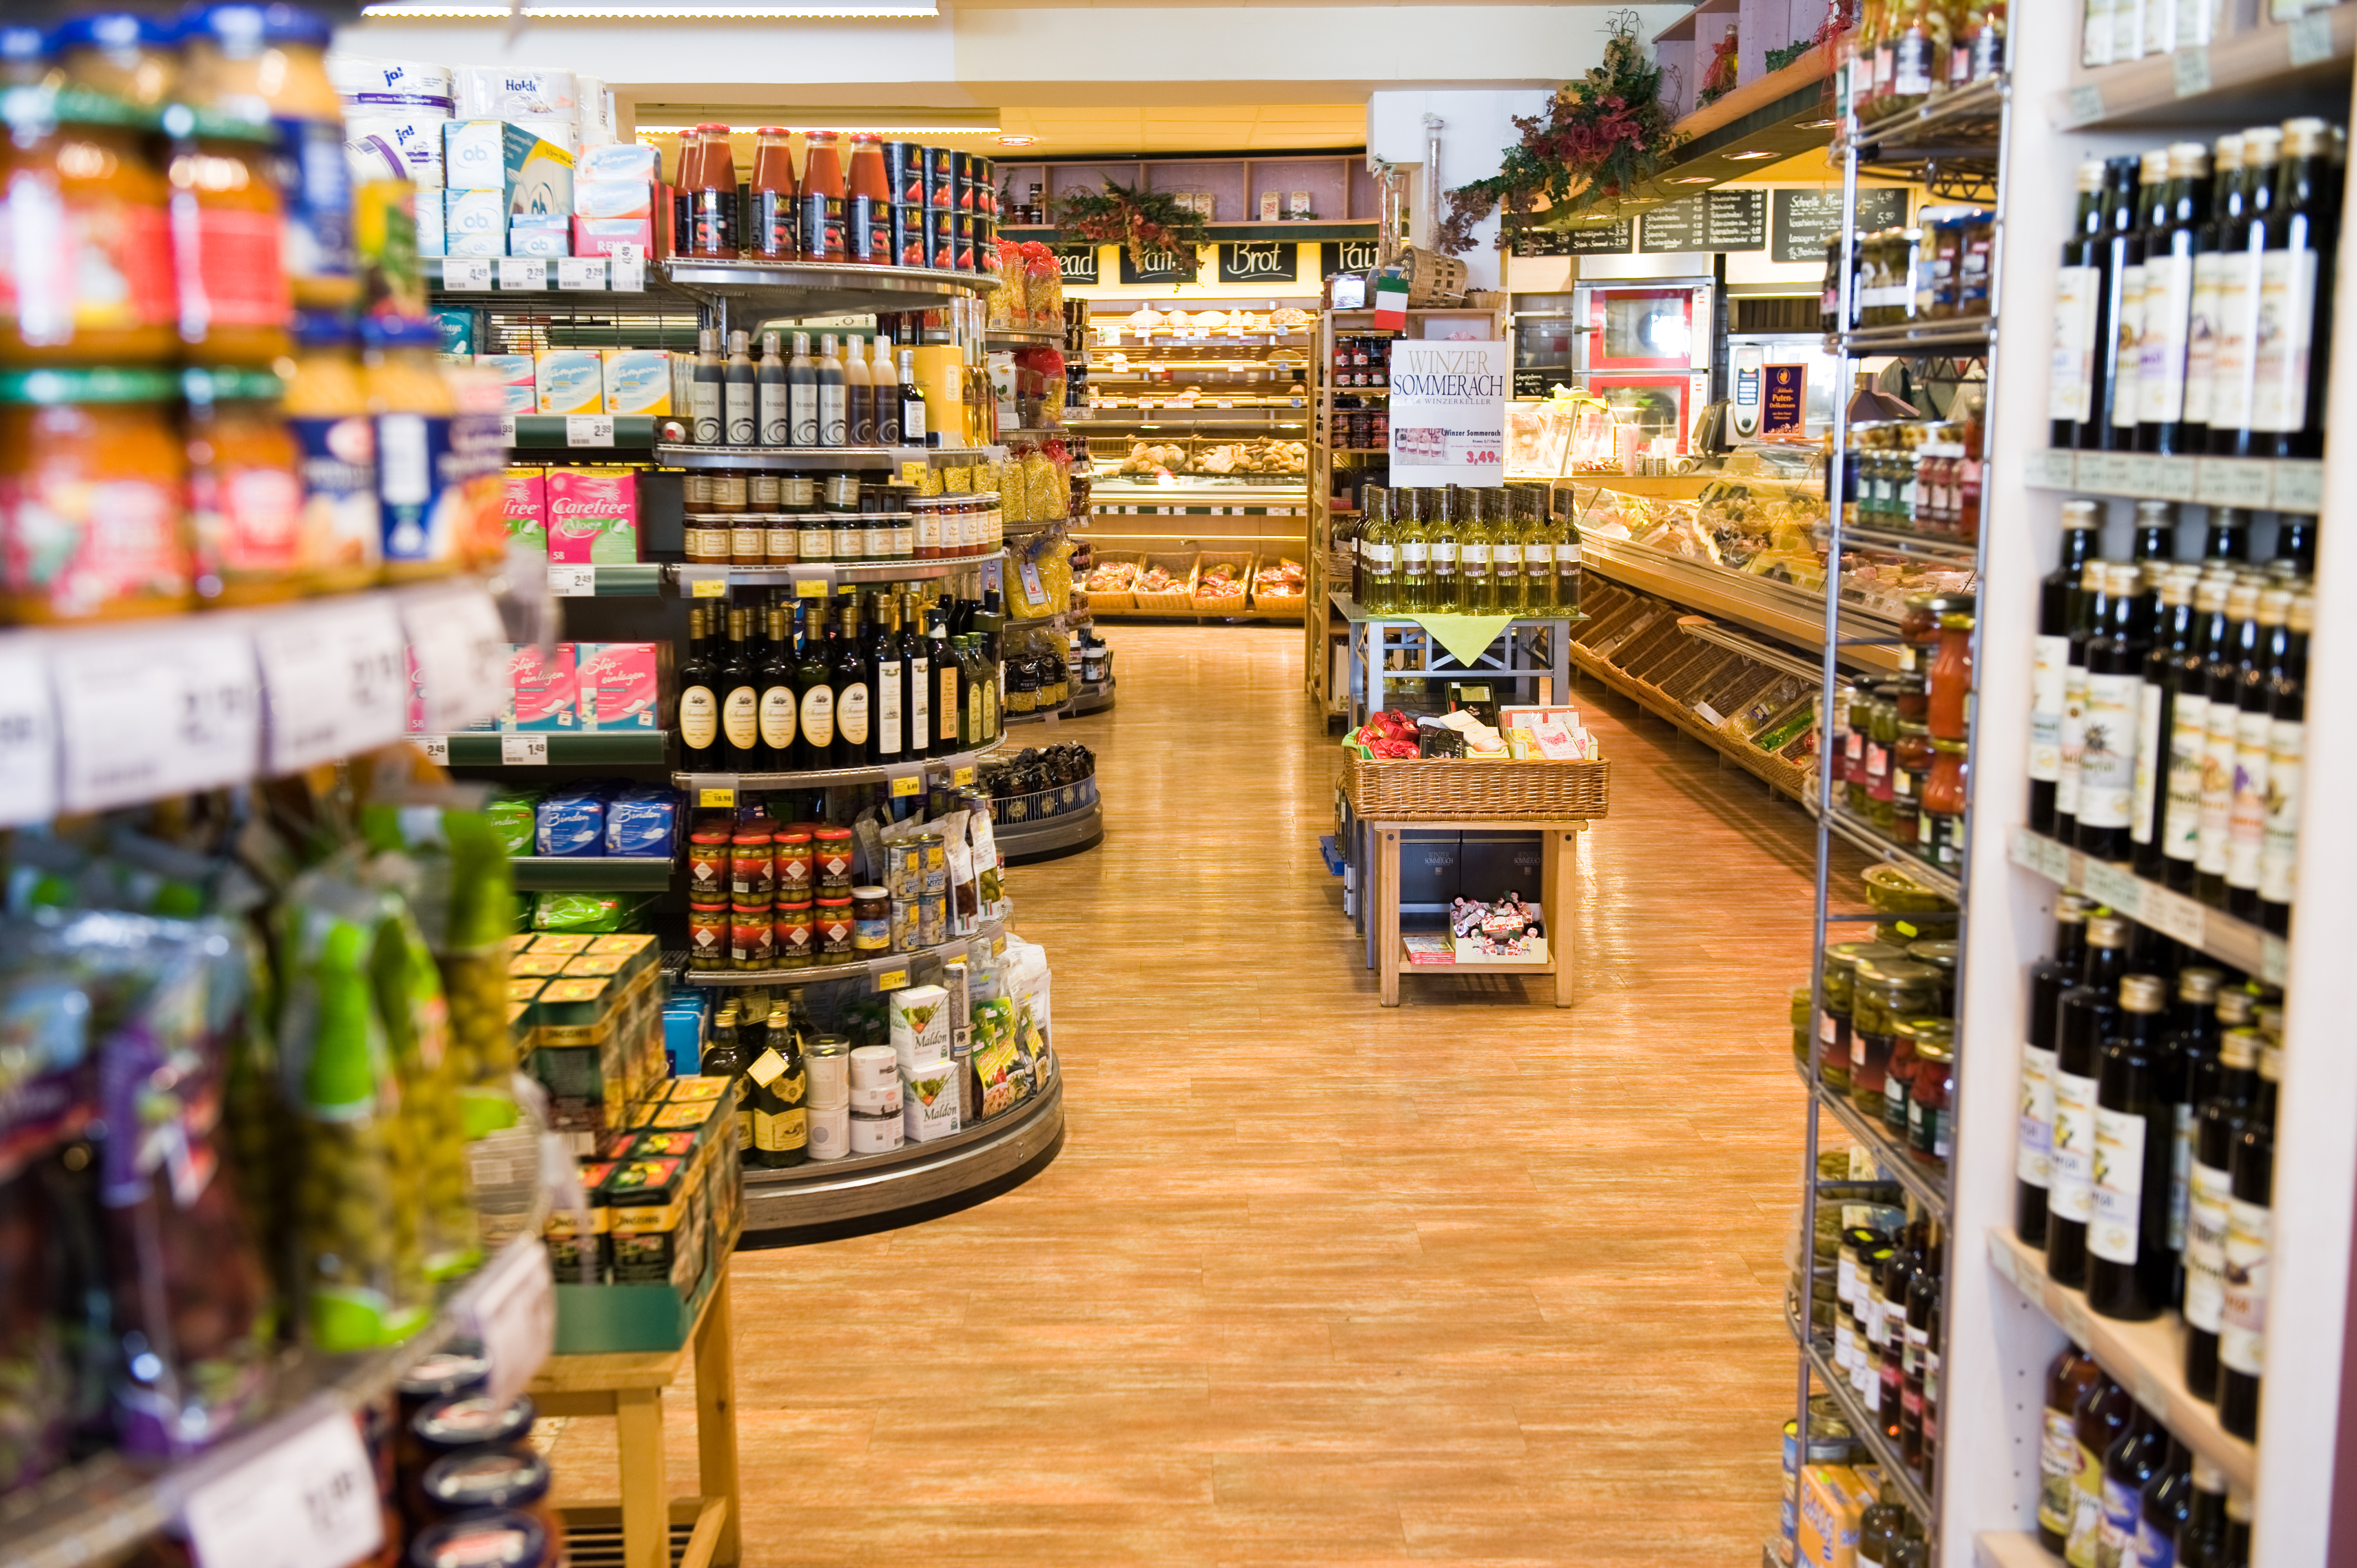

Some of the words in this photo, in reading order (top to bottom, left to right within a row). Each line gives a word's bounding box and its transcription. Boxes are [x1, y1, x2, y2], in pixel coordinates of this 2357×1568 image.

[383, 67, 404, 87] ja!
[395, 126, 415, 146] ja!
[1058, 246, 1097, 276] ead
[1226, 243, 1282, 274] Brot
[436, 321, 463, 335] lways
[1407, 350, 1491, 375] WINZER
[1393, 374, 1504, 399] SOMMERACH
[1772, 394, 1794, 402] Puten-
[594, 424, 611, 436] 2.99
[503, 499, 541, 515] free
[552, 497, 628, 515] Carefree
[553, 551, 565, 560] 58
[505, 658, 542, 675] Slip-
[585, 657, 622, 675] Slip-
[519, 670, 565, 685] einlagen
[601, 670, 646, 686] einlagen
[412, 719, 424, 728] 58
[428, 745, 445, 757] 2.49
[528, 744, 545, 756] 1.49
[544, 812, 590, 827] Binden
[614, 808, 661, 823] Binden
[914, 1031, 947, 1049] Maldon
[923, 1103, 958, 1122] Maldon
